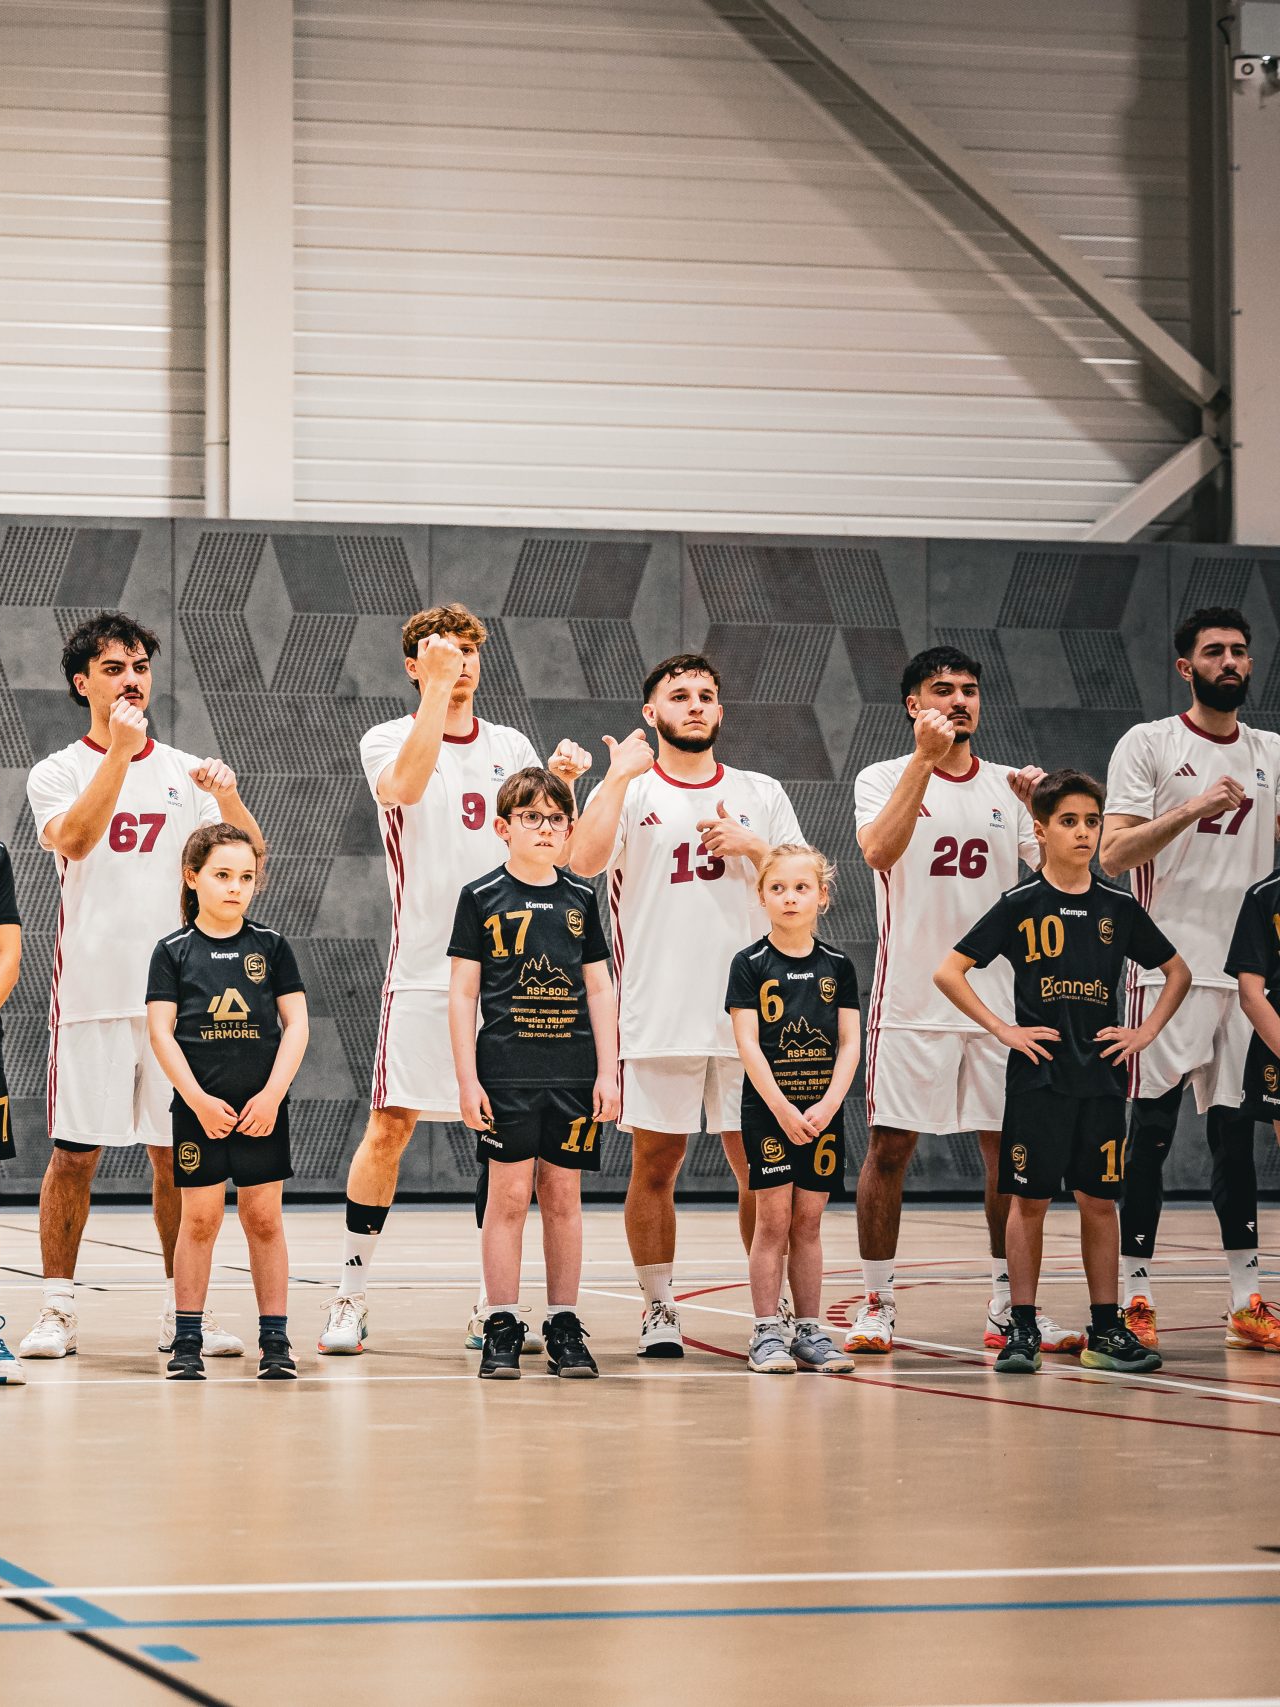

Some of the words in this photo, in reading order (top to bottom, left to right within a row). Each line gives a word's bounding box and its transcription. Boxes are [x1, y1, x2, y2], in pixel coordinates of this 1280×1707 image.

[462, 792, 485, 830] 9
[1197, 797, 1254, 835] 27
[109, 812, 166, 853] 67
[671, 842, 725, 884] 13
[930, 836, 988, 879] 26
[525, 902, 553, 910] Kempa
[1060, 908, 1087, 917] Kempa
[484, 910, 532, 957] 17
[1018, 914, 1064, 962] 10
[211, 951, 239, 961] Kempa
[527, 987, 568, 996] RSP-BOIS
[760, 979, 784, 1022] 6
[1041, 976, 1108, 999] Bonnefis
[200, 1030, 260, 1040] VERMOREL
[787, 1048, 826, 1057] RSP-BOIS
[481, 1134, 503, 1149] Kempa
[813, 1134, 836, 1176] 6
[1100, 1137, 1127, 1182] 1
[761, 1164, 791, 1175] Kempa
